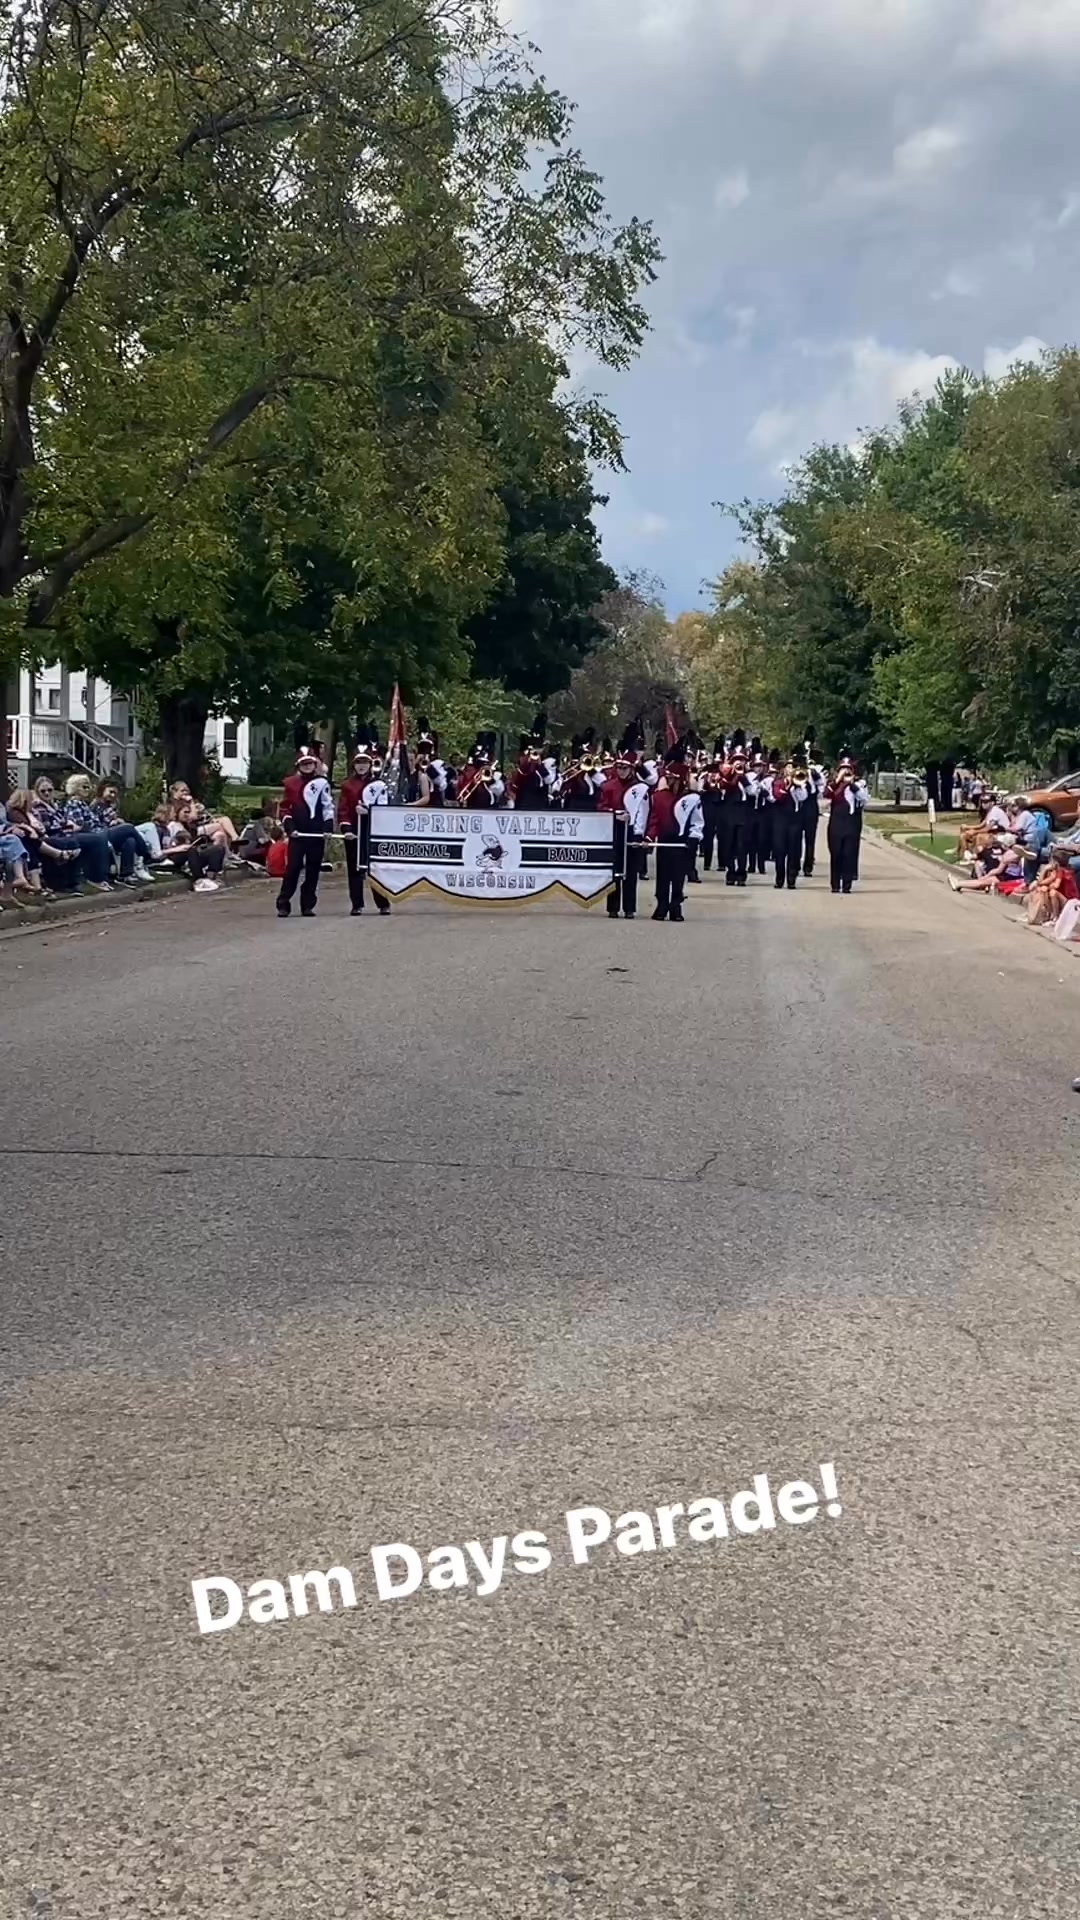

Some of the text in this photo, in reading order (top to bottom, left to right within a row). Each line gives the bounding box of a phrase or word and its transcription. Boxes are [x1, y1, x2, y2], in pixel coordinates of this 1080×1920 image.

[403, 813, 581, 836] SPRING VALLEY
[377, 842, 588, 862] CARDINAL BAND
[445, 873, 537, 889] WISCONSIN
